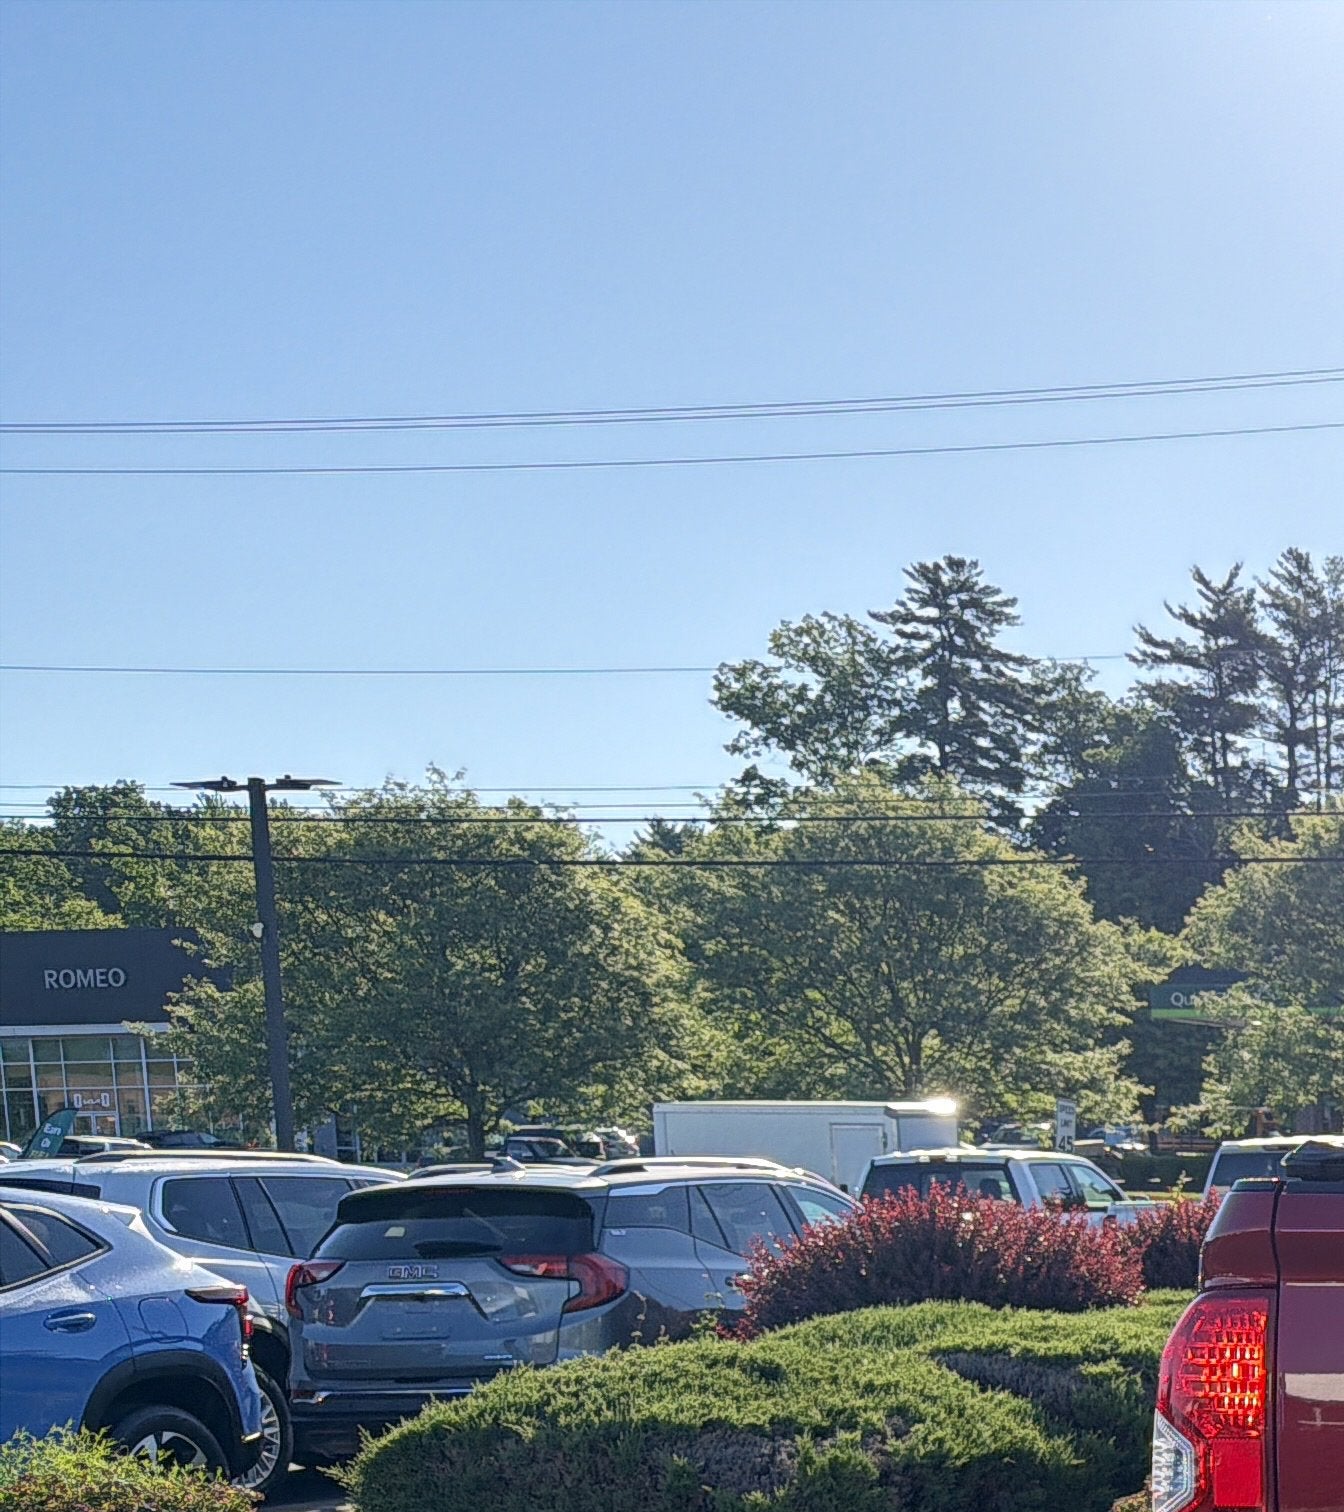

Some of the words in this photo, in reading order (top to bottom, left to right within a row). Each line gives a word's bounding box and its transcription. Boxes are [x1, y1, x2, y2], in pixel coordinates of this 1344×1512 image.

[44, 967, 126, 990] ROMEO
[1058, 1135, 1074, 1153] 45
[388, 1264, 439, 1279] GMC
